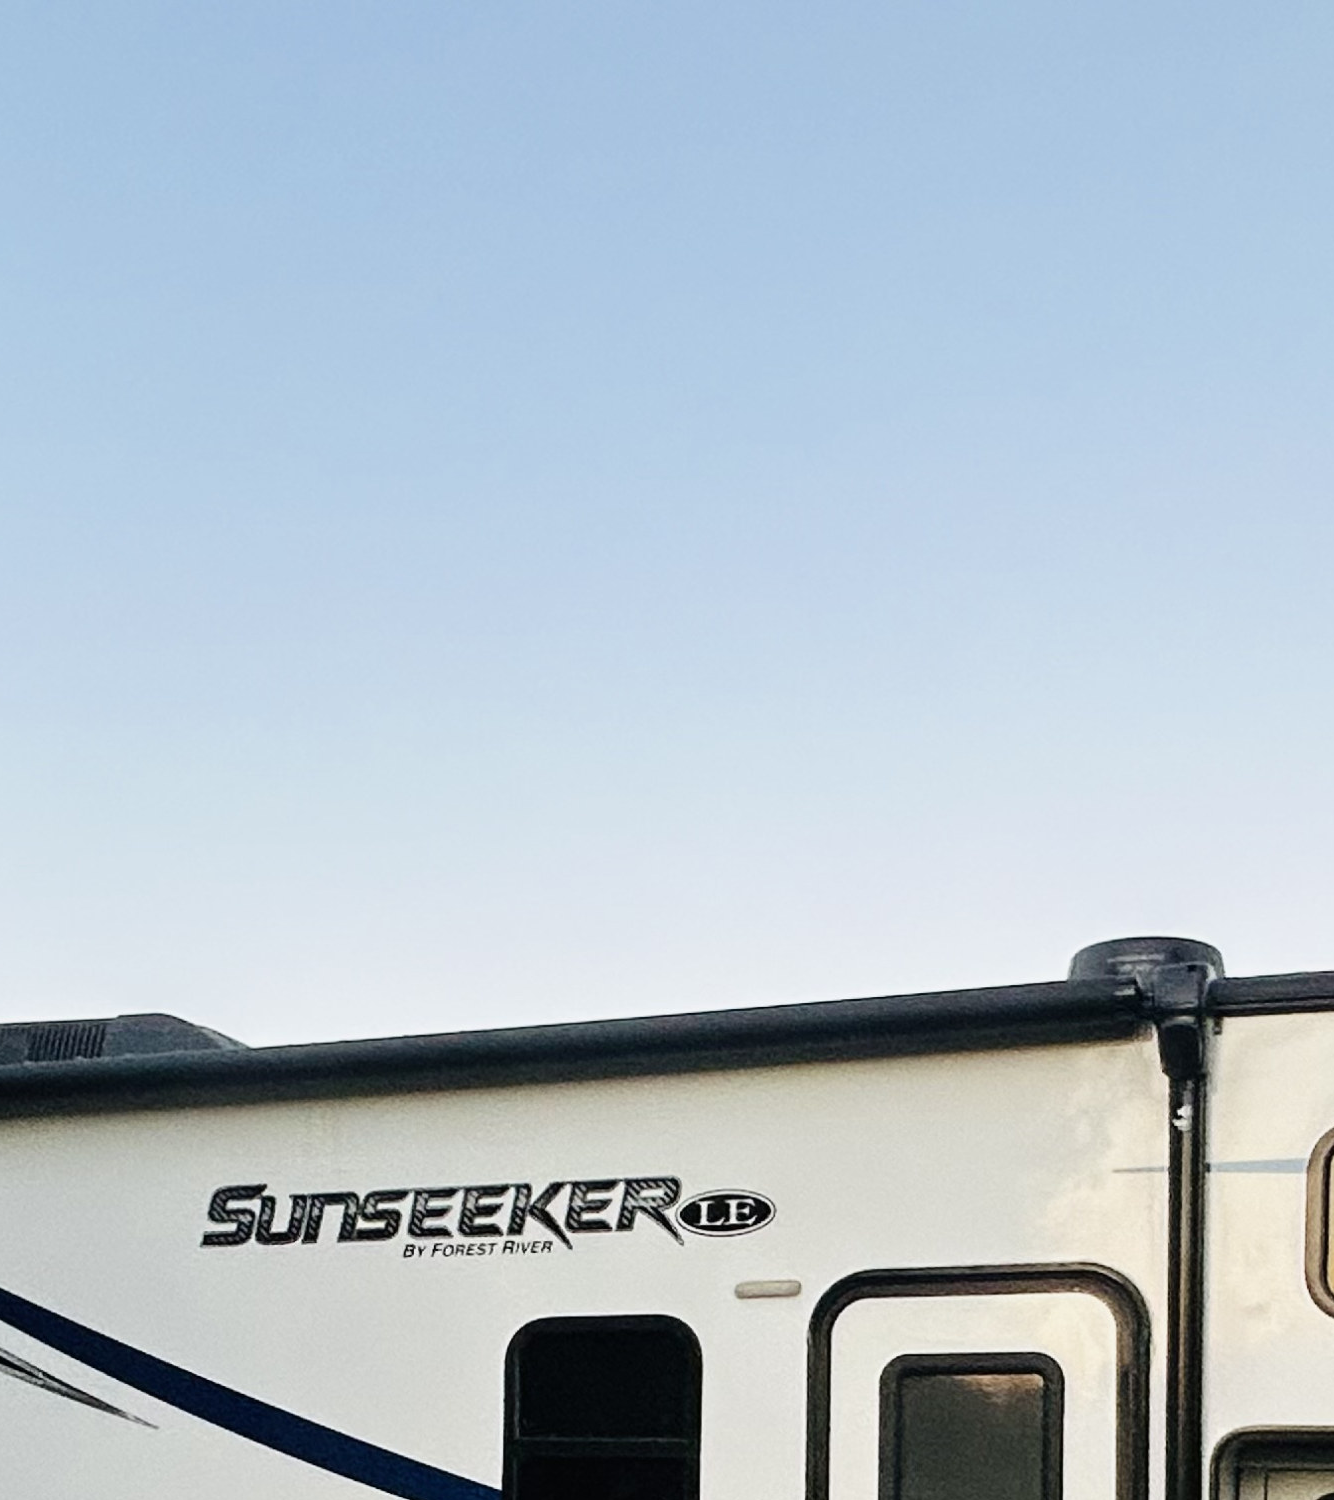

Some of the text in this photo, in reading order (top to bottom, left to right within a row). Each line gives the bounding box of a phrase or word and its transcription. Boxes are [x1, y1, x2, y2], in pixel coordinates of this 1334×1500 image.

[693, 1198, 758, 1227] LE
[403, 1240, 553, 1258] BY FOREST RIVER
